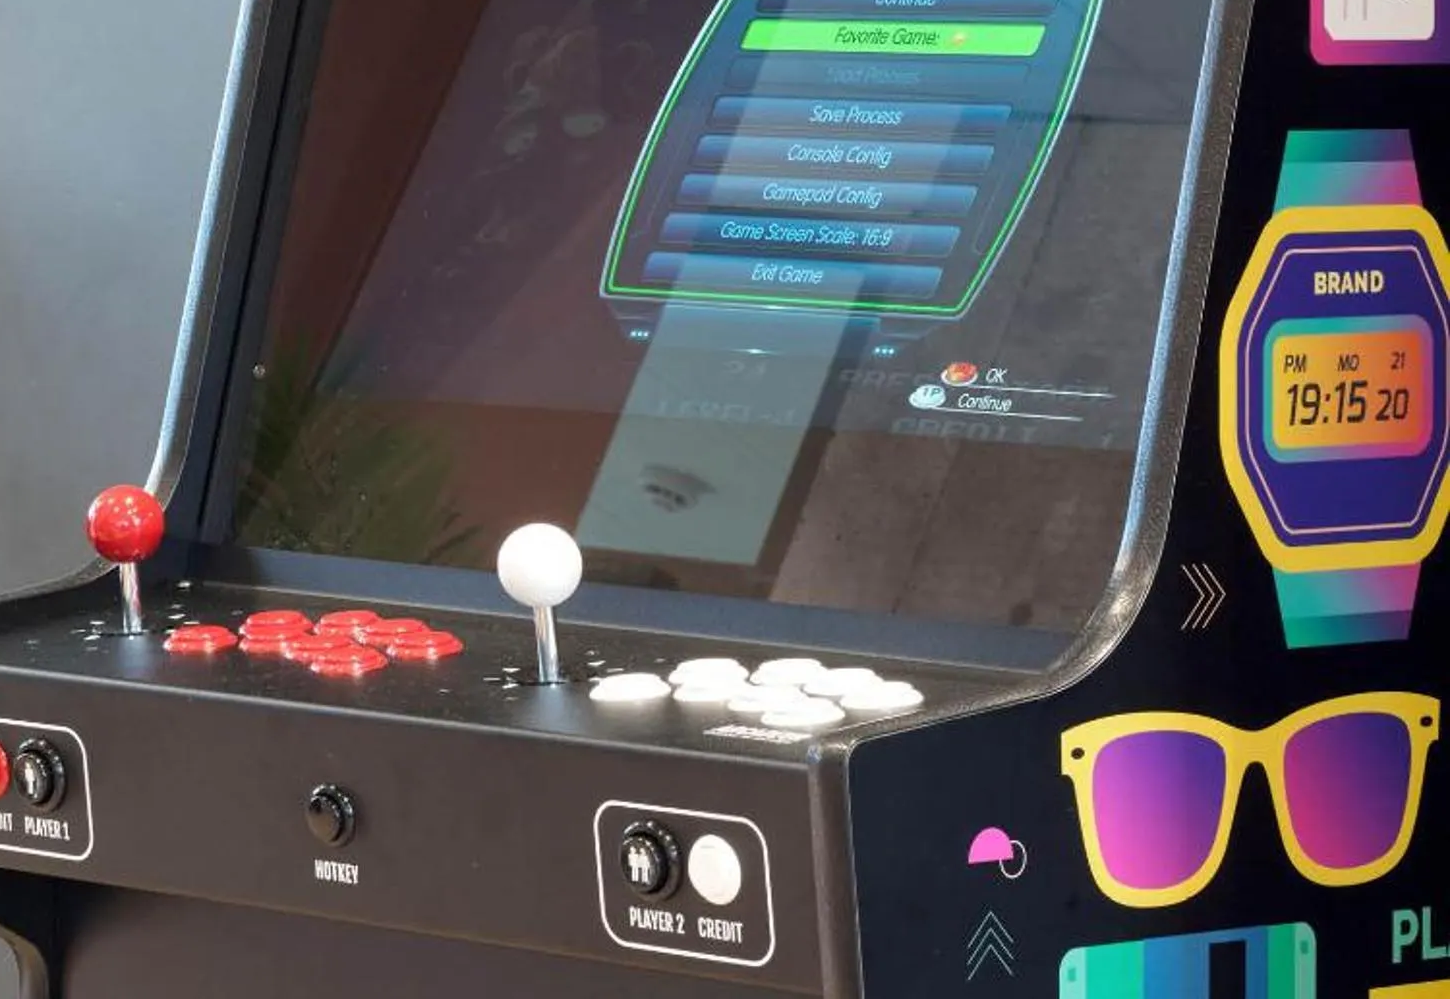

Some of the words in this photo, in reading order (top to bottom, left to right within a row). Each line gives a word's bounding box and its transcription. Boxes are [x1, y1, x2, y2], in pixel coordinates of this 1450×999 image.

[835, 26, 889, 45] Favorite
[809, 106, 846, 123] Save
[847, 107, 903, 126] Process
[787, 145, 843, 163] Console
[846, 147, 892, 169] Config
[763, 183, 836, 206] Gamepad
[837, 187, 883, 209] Config
[720, 221, 764, 240] Game
[765, 224, 814, 243] Screen
[862, 229, 894, 247] 16:9
[752, 264, 777, 281] Exit
[779, 266, 824, 284] Game
[1313, 270, 1384, 295] BRAND
[1284, 353, 1307, 373] PM
[1338, 353, 1359, 372] MO
[1391, 351, 1406, 370] 21
[986, 367, 1007, 383] OK
[958, 393, 1012, 412] Continue
[1287, 380, 1368, 426] 19:15
[1375, 388, 1409, 422] 20
[24, 816, 62, 840] PLAYER
[62, 821, 70, 841] 1
[314, 859, 359, 886] HOTKEY
[629, 905, 674, 933] PLAYER
[675, 912, 686, 935] 2
[697, 916, 743, 944] CREDIT
[1392, 905, 1450, 964] PL
